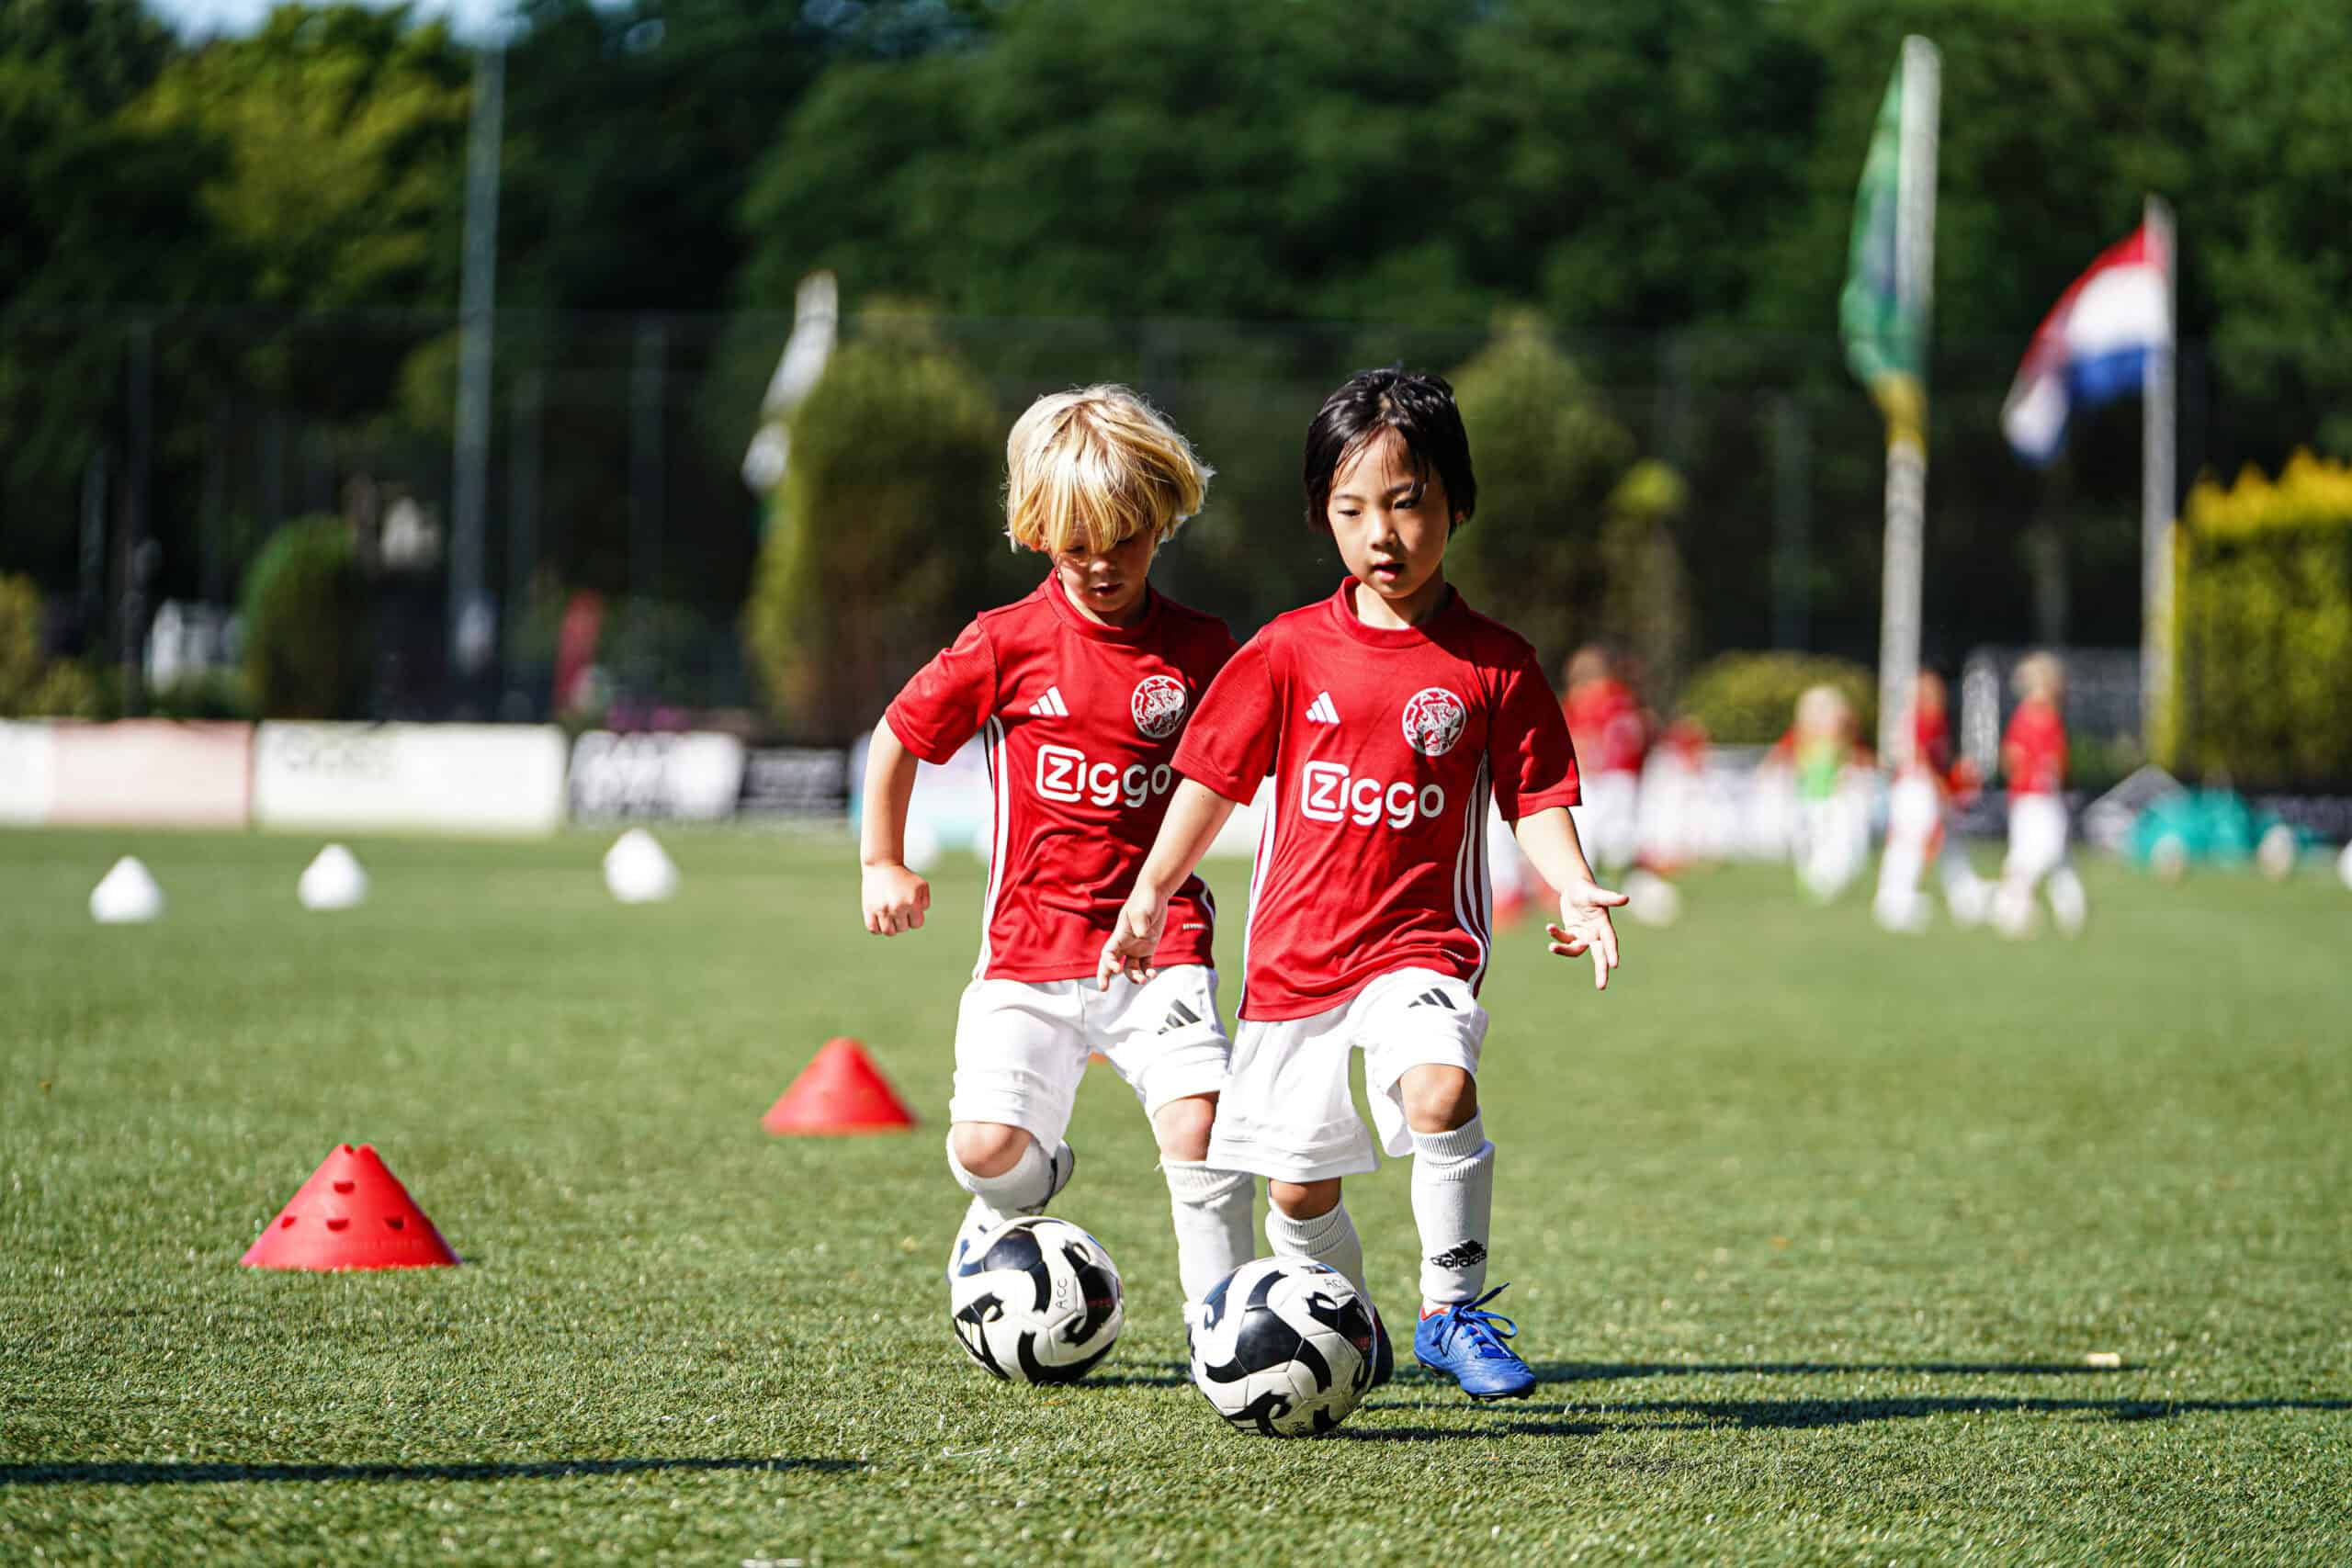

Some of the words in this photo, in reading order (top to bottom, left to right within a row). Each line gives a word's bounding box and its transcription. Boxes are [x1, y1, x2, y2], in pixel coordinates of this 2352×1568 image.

[1035, 744, 1171, 807] Ziggo
[1301, 761, 1445, 829] Ziggo
[1056, 1278, 1068, 1310] ACC
